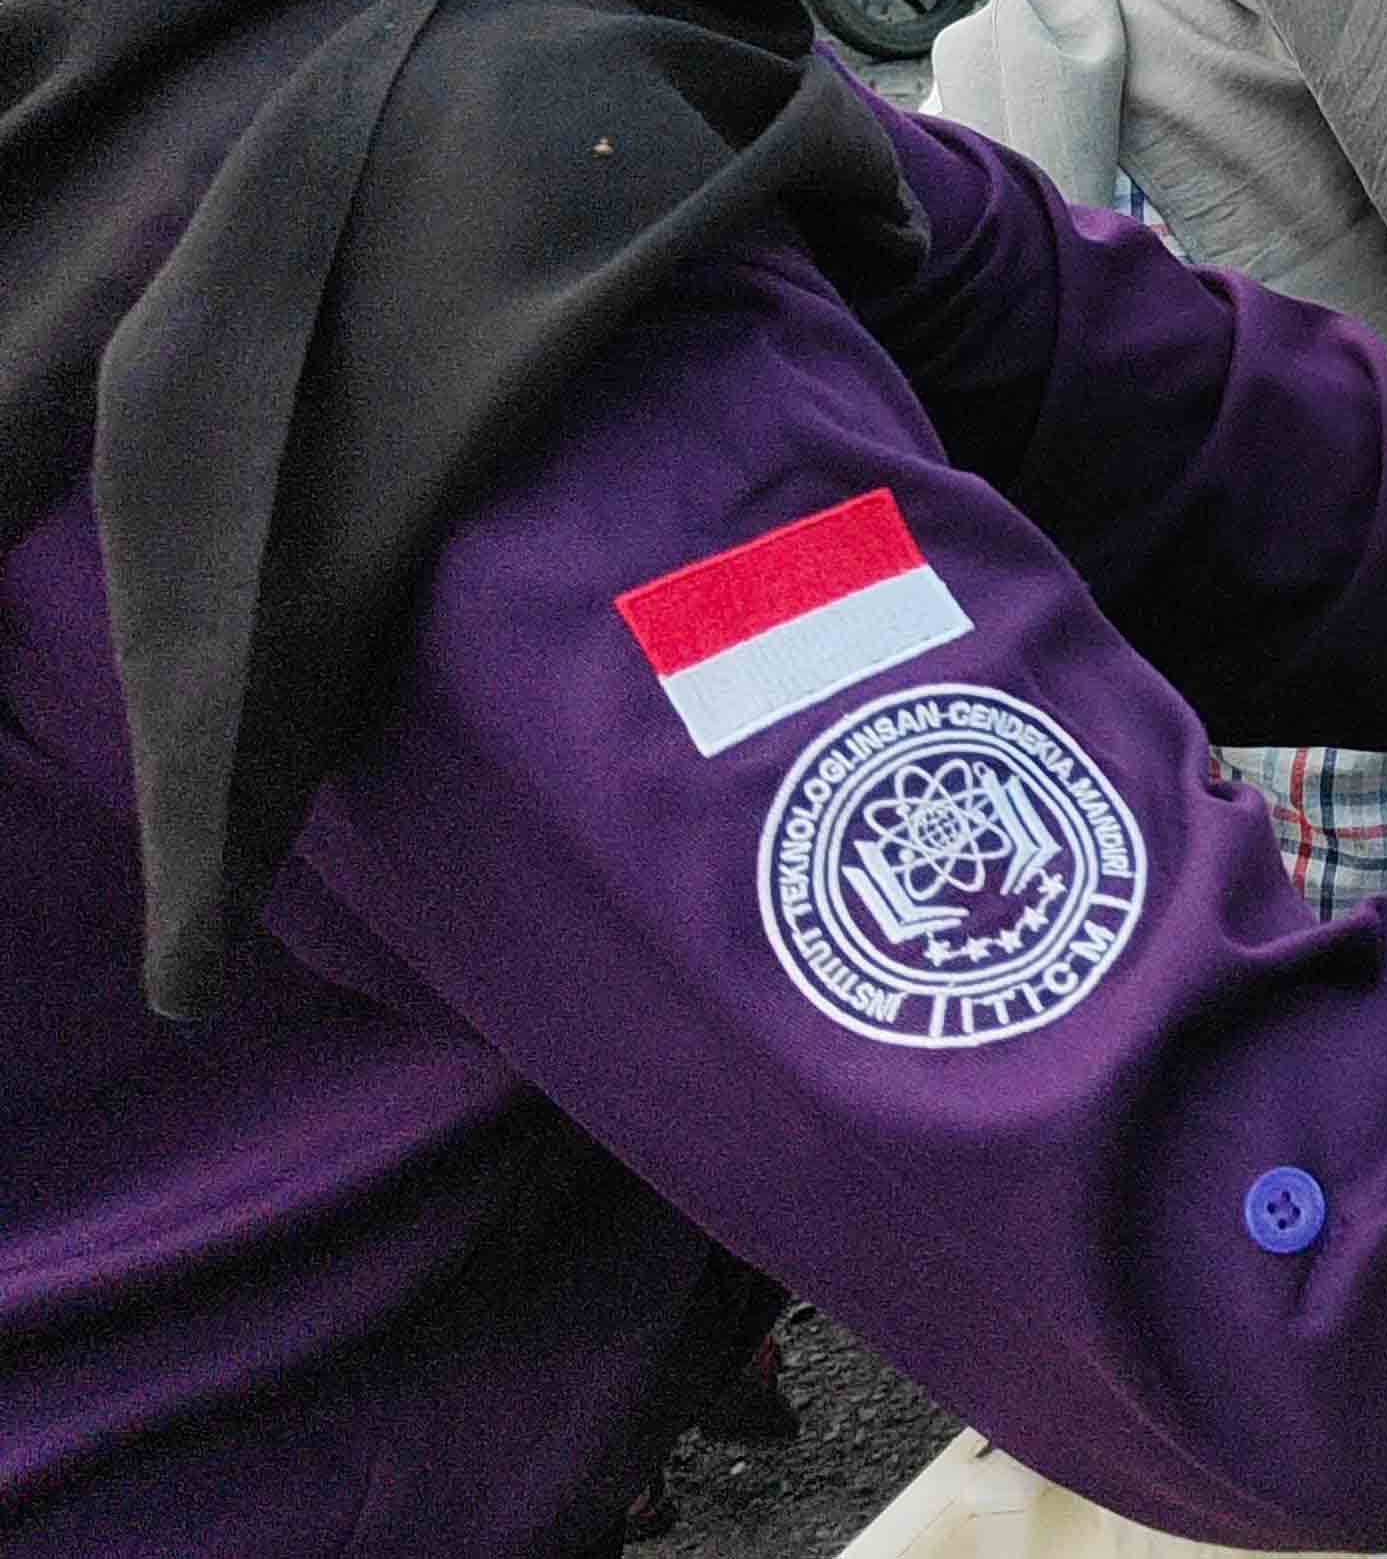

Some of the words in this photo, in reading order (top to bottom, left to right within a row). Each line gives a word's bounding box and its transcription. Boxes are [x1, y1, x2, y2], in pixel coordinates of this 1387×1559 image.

[845, 701, 942, 761] INSAN
[949, 700, 1074, 781] CENDEKIA
[778, 749, 856, 929] TEKNOLOGI
[1070, 776, 1133, 879] MANDIRI
[792, 927, 904, 1024] INSTITUT
